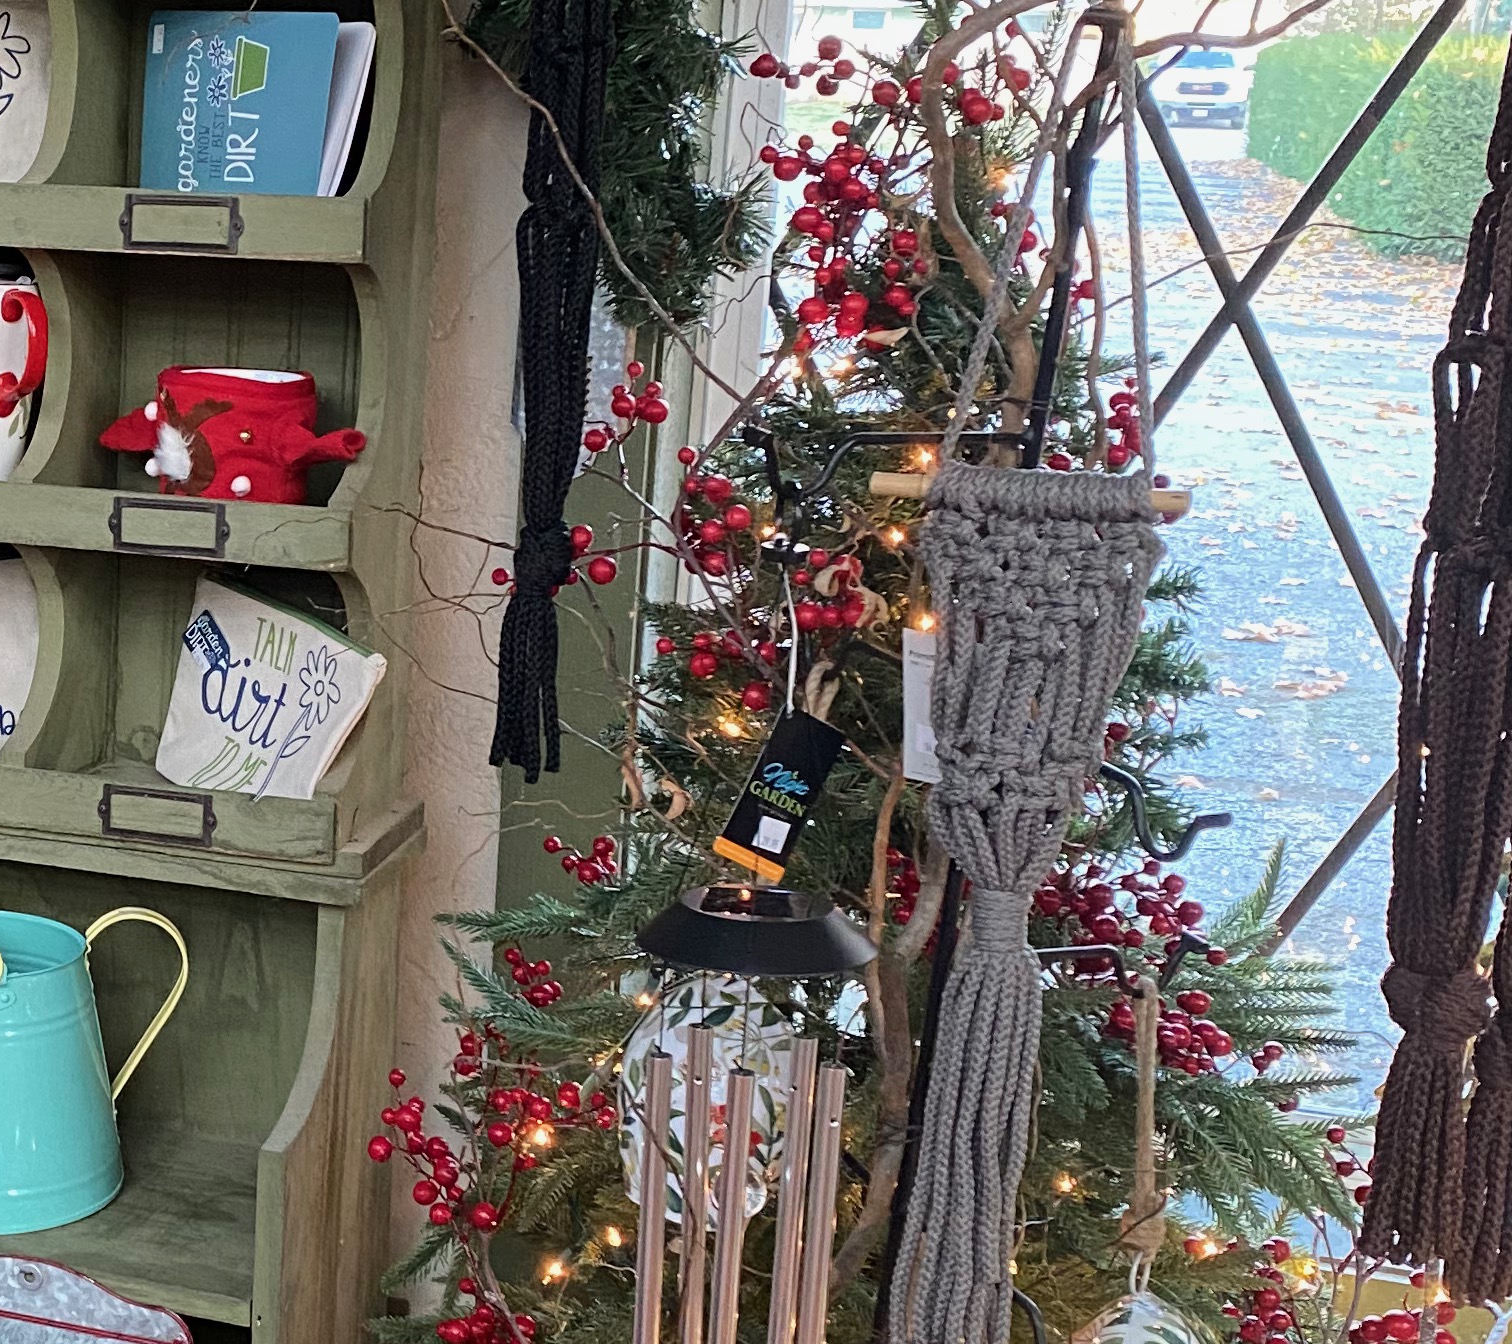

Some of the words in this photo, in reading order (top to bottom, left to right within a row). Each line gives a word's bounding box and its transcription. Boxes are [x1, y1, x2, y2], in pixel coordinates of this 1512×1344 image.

[197, 125, 210, 164] KNOW
[212, 111, 226, 148] BEST
[223, 103, 260, 183] DIRT
[209, 154, 222, 179] THE
[253, 617, 297, 675] TALK
[202, 654, 287, 749] dirt
[187, 736, 240, 788] TO
[750, 780, 806, 817] GARDEN
